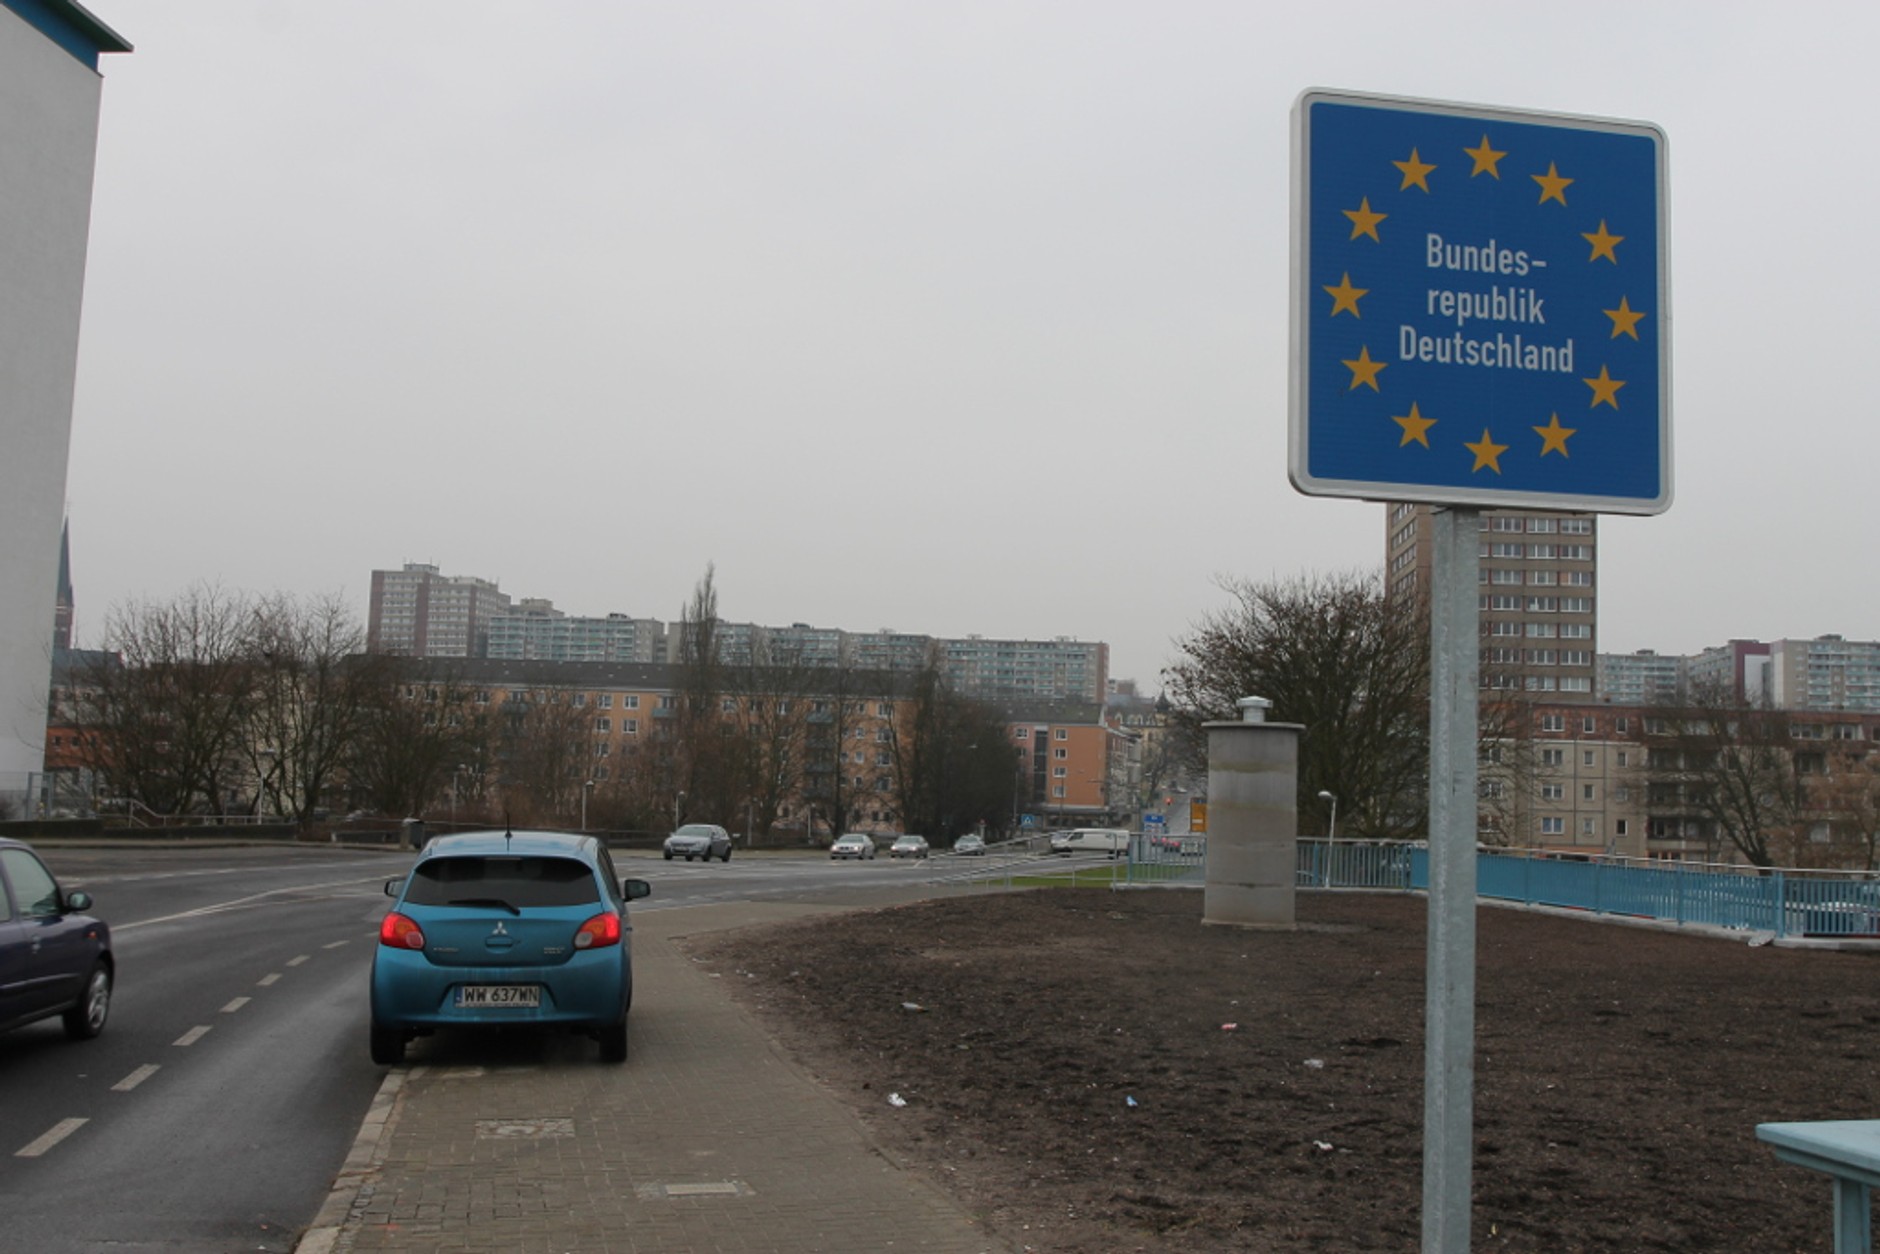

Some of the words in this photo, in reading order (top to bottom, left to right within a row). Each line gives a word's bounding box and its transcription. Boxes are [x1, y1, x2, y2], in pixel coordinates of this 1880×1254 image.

[1426, 233, 1547, 276] Bundes-
[1427, 285, 1546, 326] republik
[1400, 324, 1573, 373] Deutschland
[464, 987, 487, 1002] WW
[491, 987, 538, 1002] 637WN
